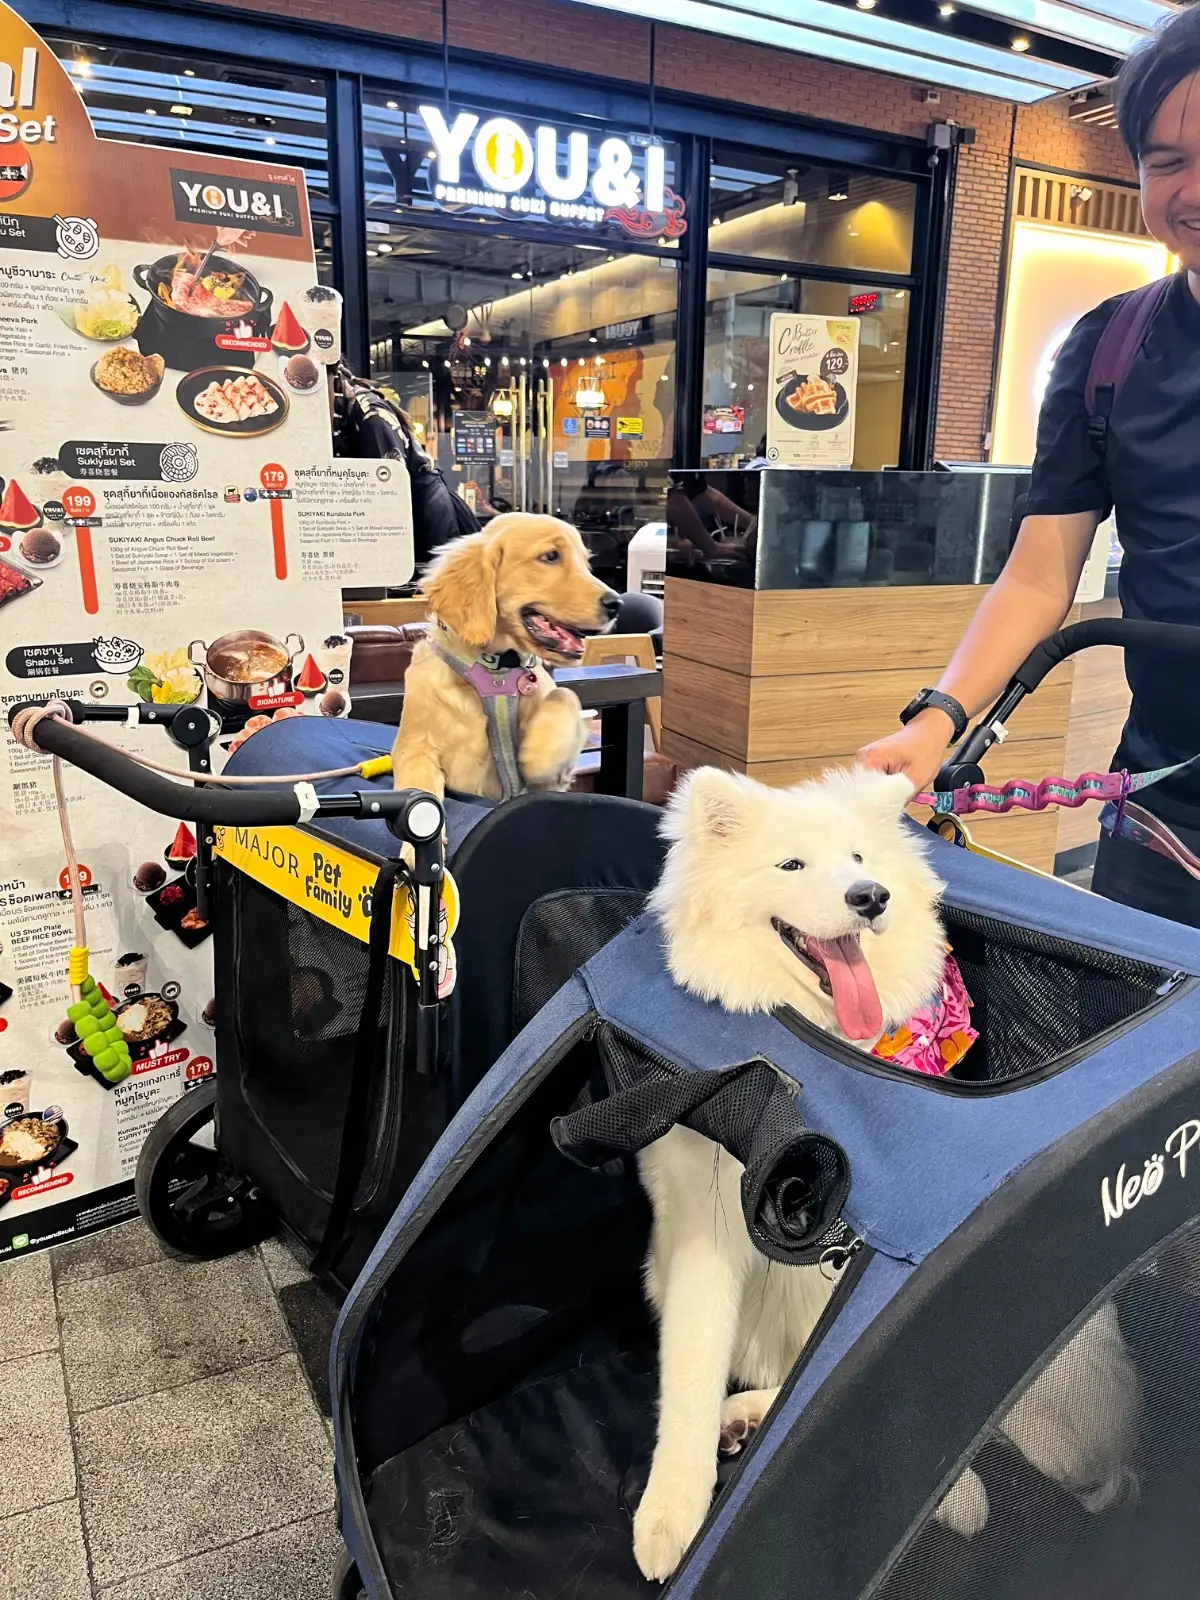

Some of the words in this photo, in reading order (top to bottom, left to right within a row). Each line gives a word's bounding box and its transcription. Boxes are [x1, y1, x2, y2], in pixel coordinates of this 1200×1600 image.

[0, 113, 56, 142] Set
[419, 105, 665, 213] YOU&I
[178, 181, 283, 218] YOU&I
[435, 184, 507, 209] PREMIUM
[510, 196, 546, 216] SUKI
[549, 202, 605, 223] BUFFET
[189, 207, 217, 216] PREMIUM
[8, 228, 26, 238] Set
[77, 457, 118, 468] Sukiyaki
[119, 457, 136, 467] Set
[263, 471, 285, 482] 179
[66, 495, 92, 507] 199
[143, 536, 165, 544] Angus
[25, 658, 56, 668] Shabu
[58, 657, 74, 665] Set
[257, 695, 295, 706] SIGNATURE
[235, 826, 300, 879] MAJOR
[313, 852, 342, 886] Pet
[63, 871, 87, 884] 19
[305, 876, 352, 919] Family
[10, 930, 22, 938] US
[22, 927, 42, 936] Short
[43, 924, 62, 933] Plate
[11, 936, 31, 945] BEEF
[32, 932, 49, 941] RICE
[51, 929, 74, 937] BOWL
[135, 1059, 161, 1072] MUST
[163, 1052, 182, 1064] TRY
[189, 1062, 210, 1075] 179
[118, 1131, 141, 1142] CURRY
[17, 1176, 69, 1197] RECOMMENDED
